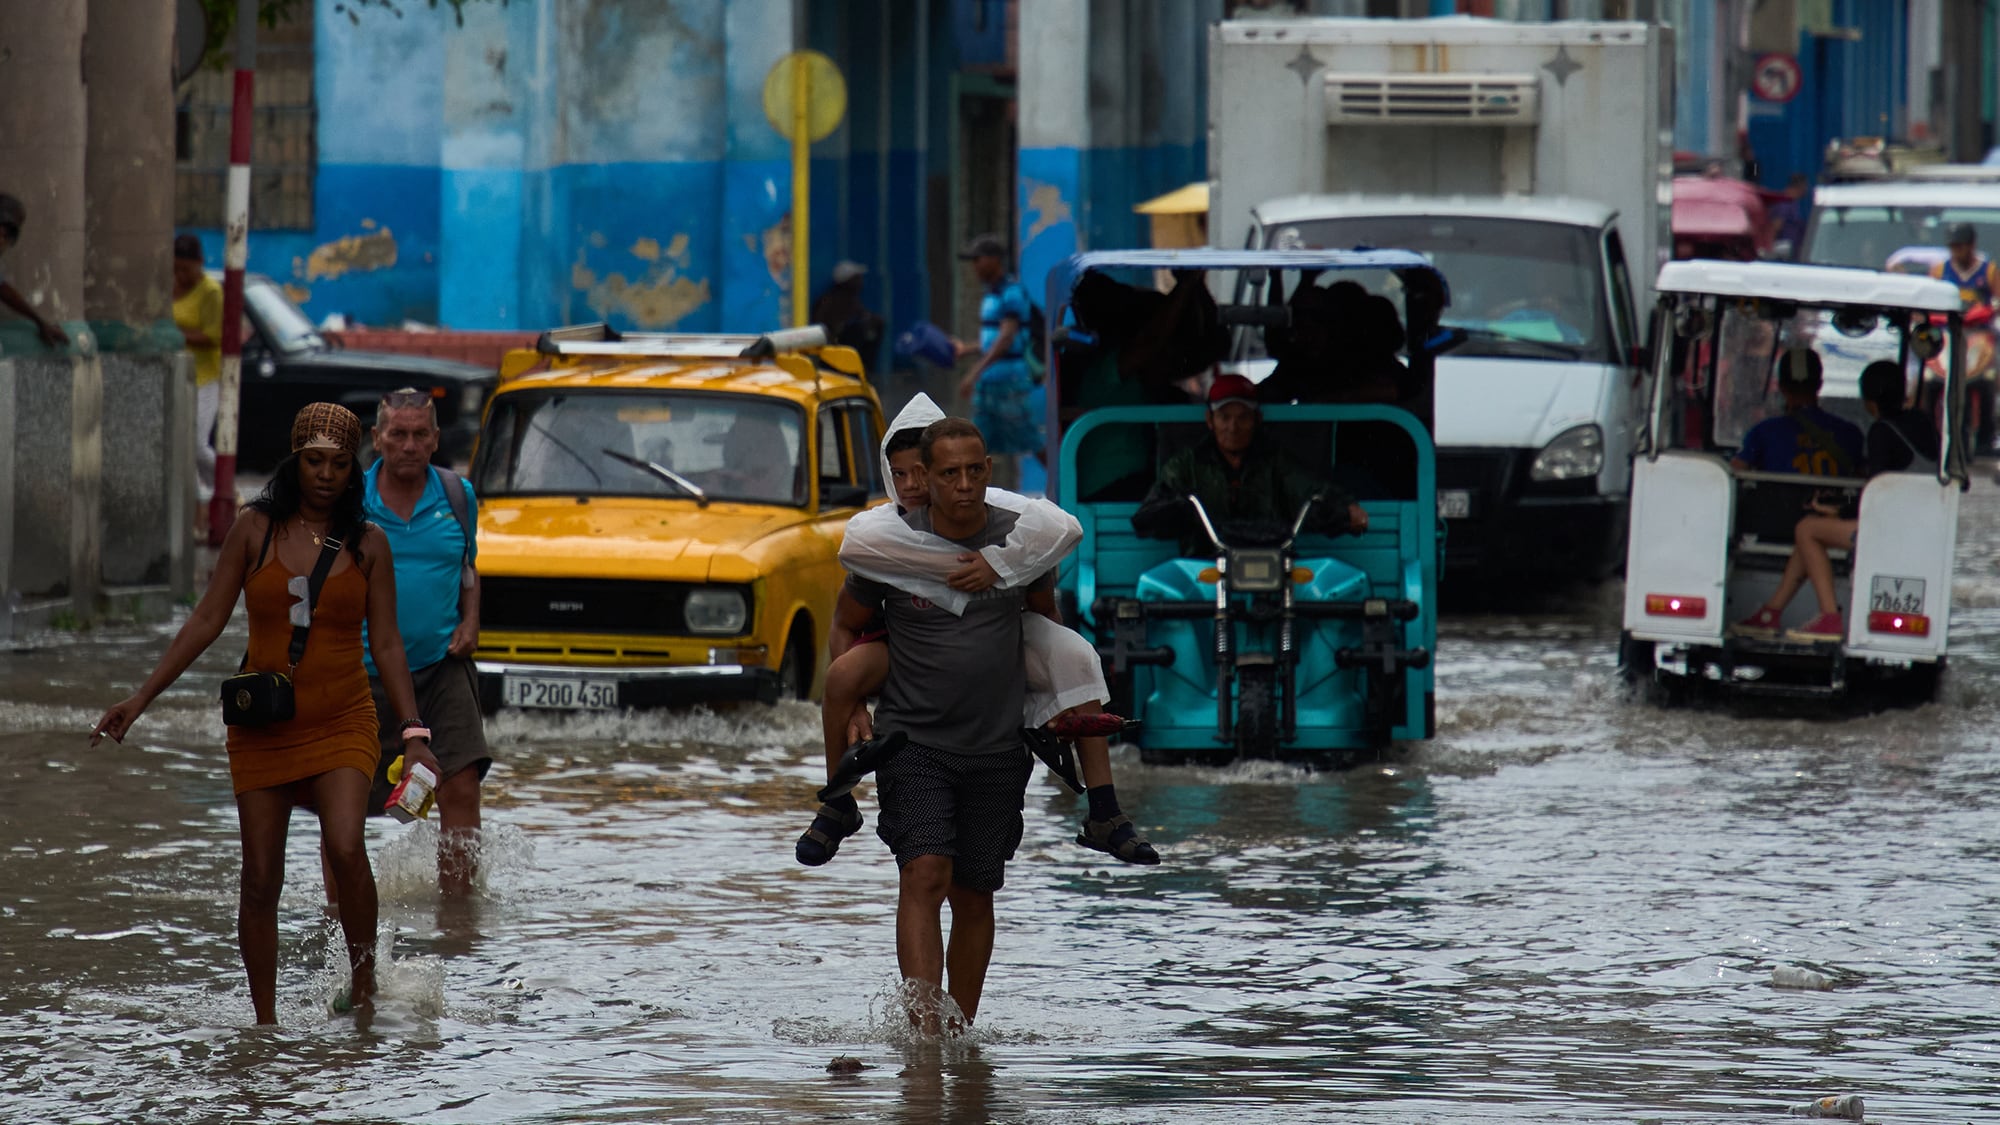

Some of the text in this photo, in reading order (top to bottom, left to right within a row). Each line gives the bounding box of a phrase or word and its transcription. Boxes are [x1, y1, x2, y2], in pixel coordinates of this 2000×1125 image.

[1894, 579, 1904, 593] V
[520, 682, 532, 704] P
[536, 684, 572, 706] 200
[577, 682, 615, 707] 430
